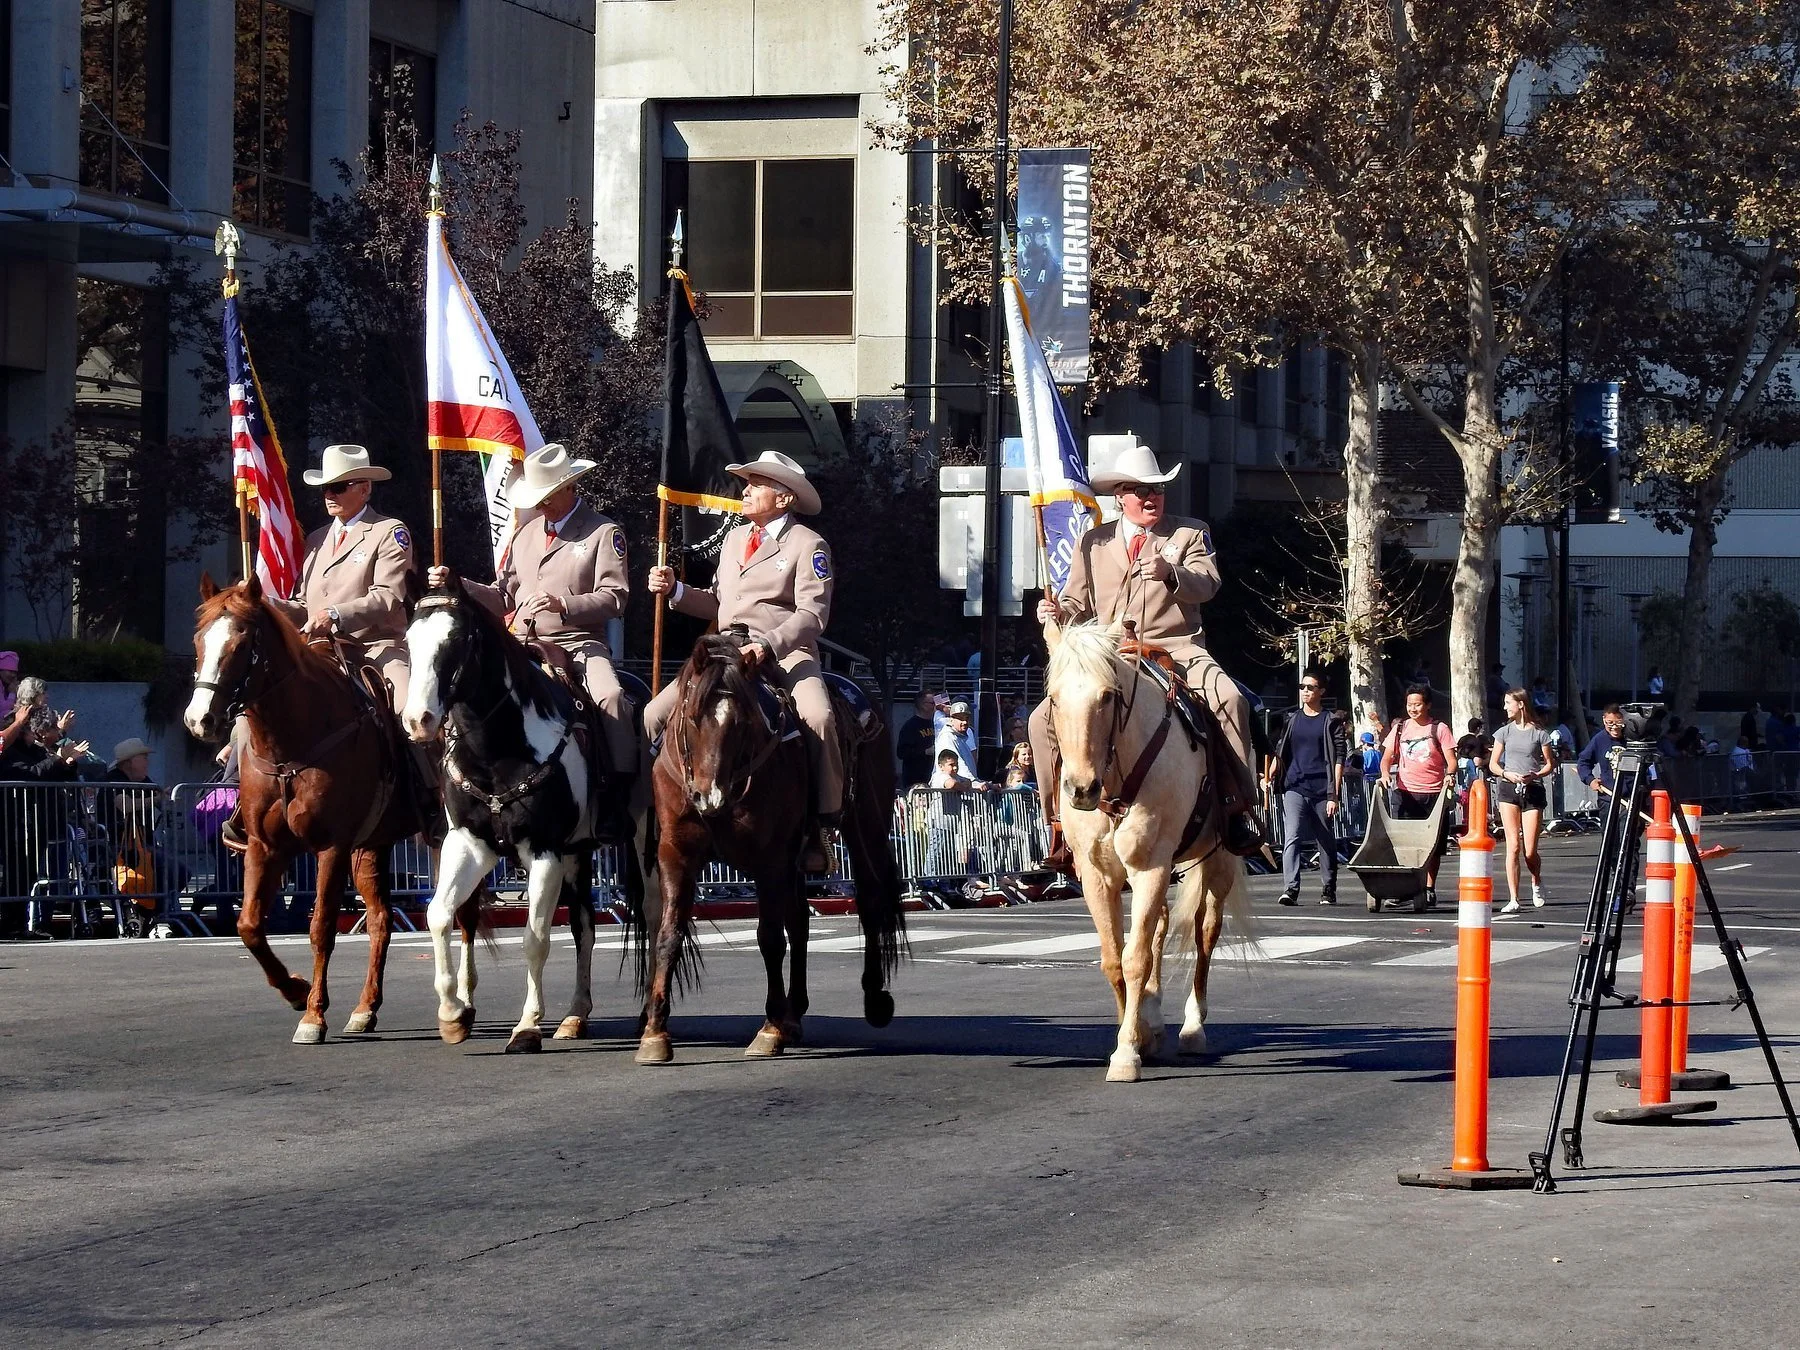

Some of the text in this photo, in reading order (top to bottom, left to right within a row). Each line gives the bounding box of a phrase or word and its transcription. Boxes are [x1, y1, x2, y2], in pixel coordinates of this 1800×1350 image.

[1062, 163, 1088, 308] THORNTON
[1601, 392, 1618, 449] VLASIC
[708, 541, 723, 557] ARE
